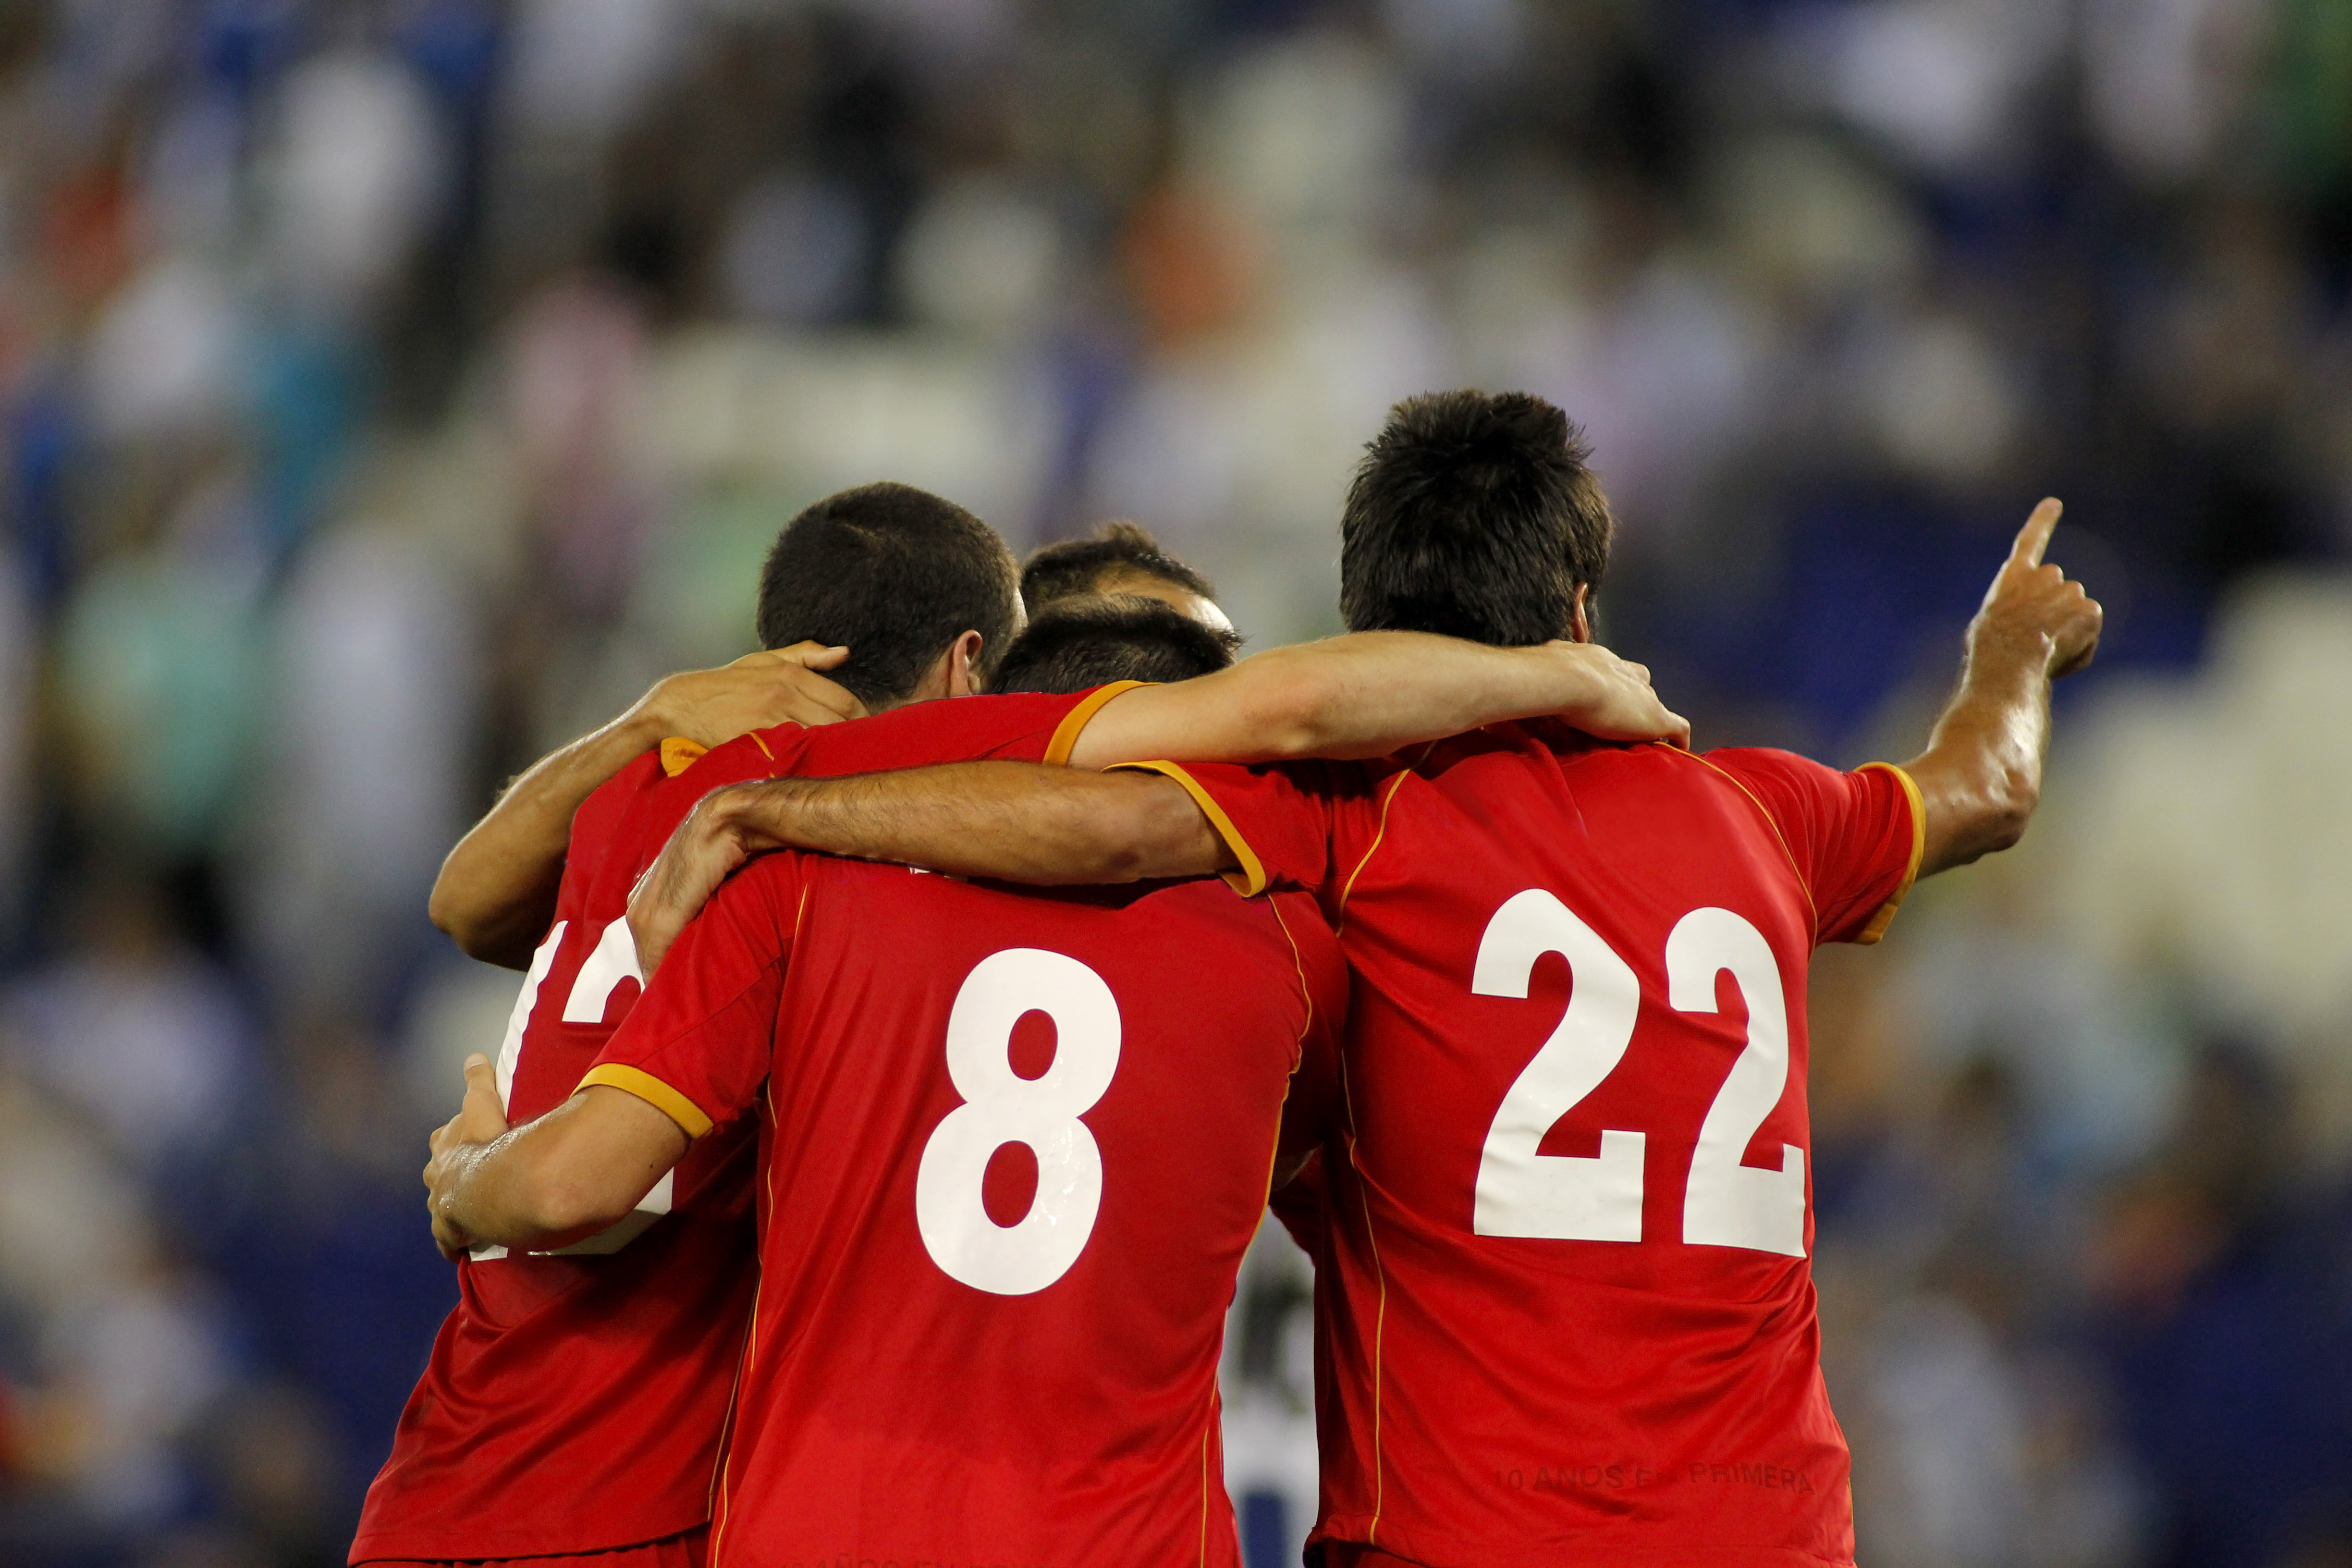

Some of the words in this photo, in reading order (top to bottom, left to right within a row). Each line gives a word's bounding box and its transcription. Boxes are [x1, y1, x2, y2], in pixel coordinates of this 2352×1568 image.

[916, 948, 1122, 1296] 8
[1471, 889, 1807, 1258] 22
[1492, 1469, 1524, 1490] 10
[1688, 1461, 1815, 1495] PRIMERA
